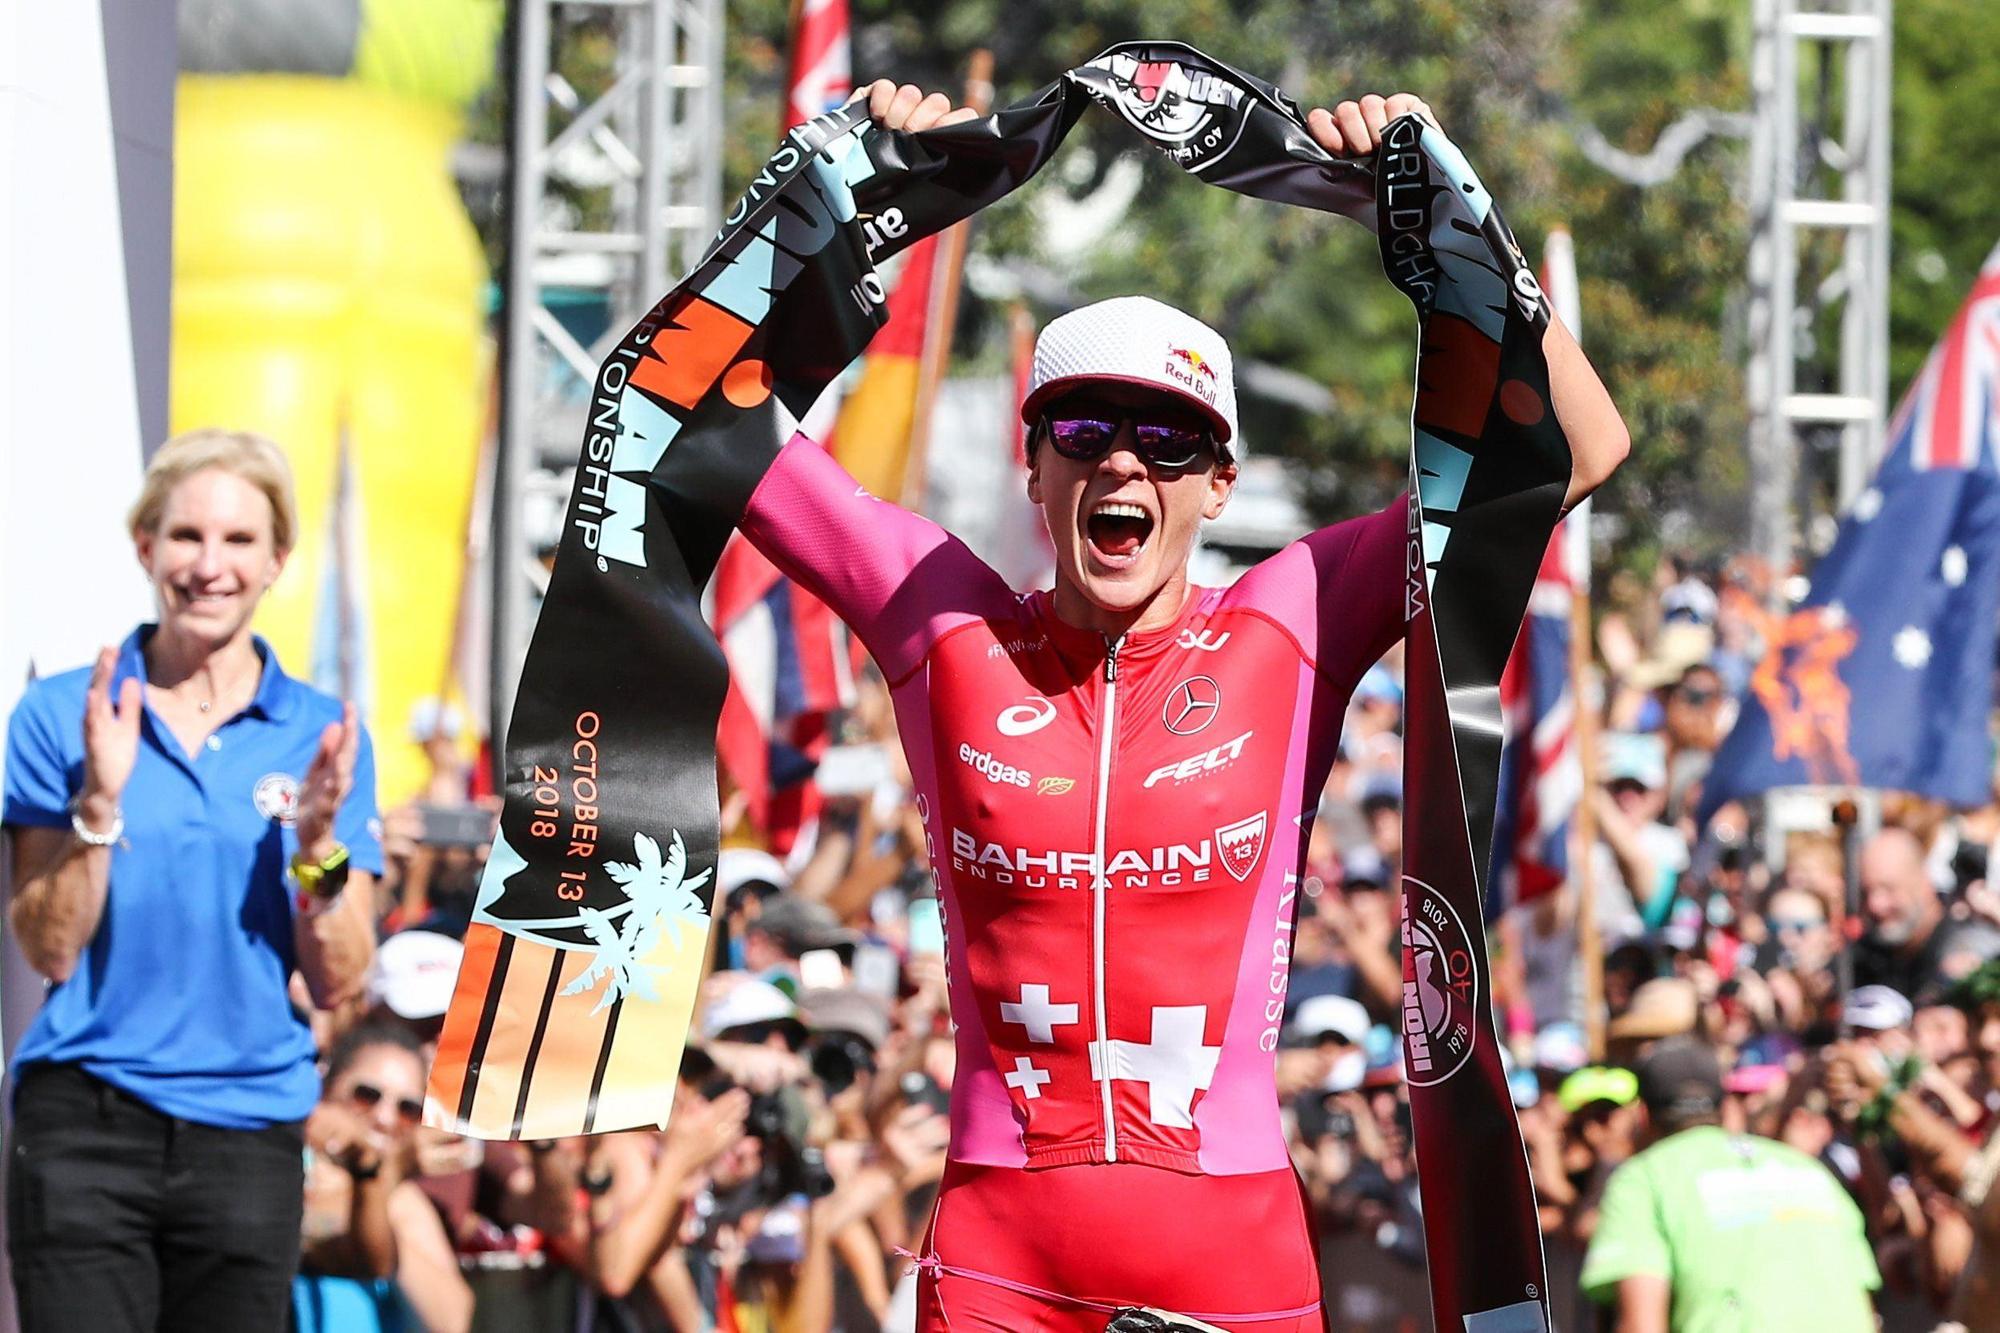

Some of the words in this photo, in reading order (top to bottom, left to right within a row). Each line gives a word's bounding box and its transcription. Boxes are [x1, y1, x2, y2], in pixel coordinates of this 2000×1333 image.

[1204, 126, 1222, 148] 40
[1387, 121, 1424, 231] ORLD
[1165, 362, 1193, 386] Red
[1195, 379, 1217, 407] Bull
[958, 741, 1033, 789] erdgas
[1143, 729, 1254, 789] FELT
[530, 765, 560, 839] 2018
[567, 711, 600, 859] OCTOBER
[952, 827, 1211, 877] BAHRAIN
[954, 857, 1210, 890] ENDURANCE
[1233, 843, 1252, 860] 13
[557, 871, 587, 902] 13
[1422, 897, 1449, 931] 2018
[1445, 950, 1472, 1004] 40
[1446, 1022, 1468, 1055] 1978
